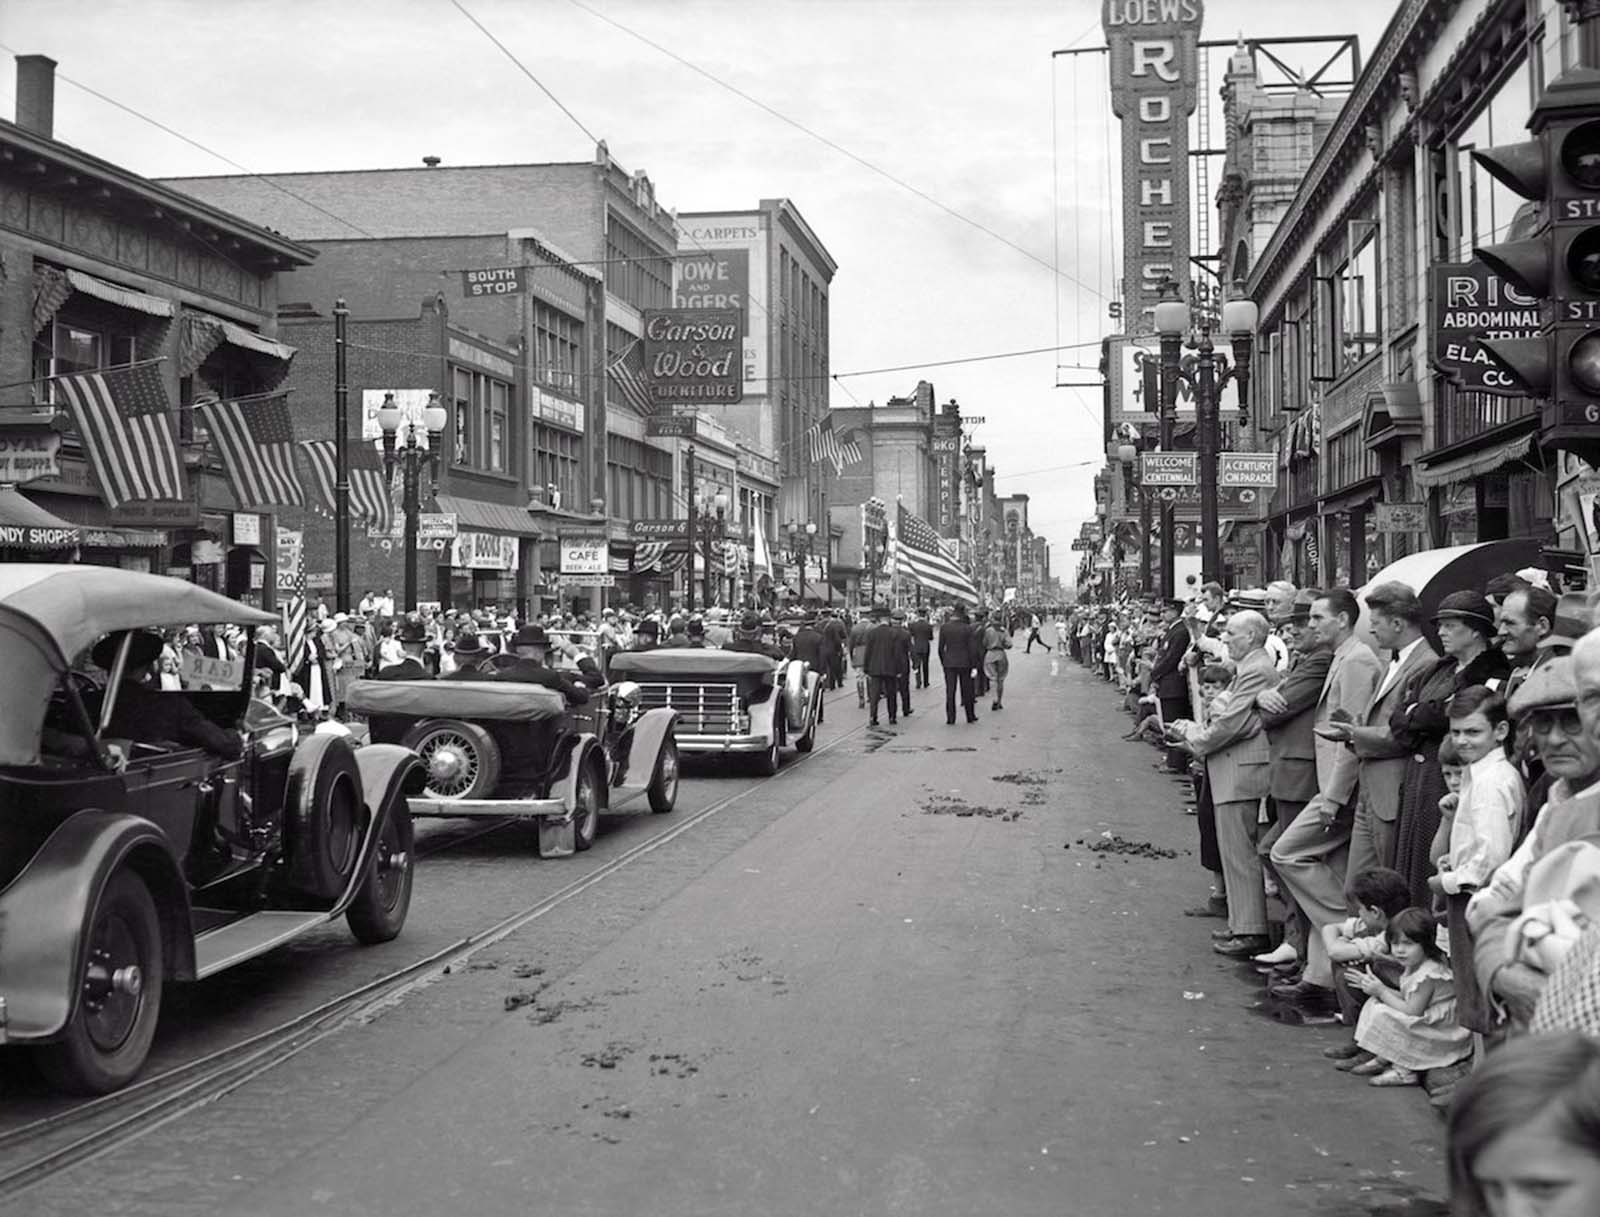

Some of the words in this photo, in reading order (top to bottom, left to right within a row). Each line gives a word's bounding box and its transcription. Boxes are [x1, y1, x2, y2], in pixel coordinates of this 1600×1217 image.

[1567, 200, 1600, 217] ST
[692, 227, 757, 239] CARPETS
[468, 269, 516, 282] SOUTH
[472, 282, 518, 295] STOP
[1443, 311, 1540, 328] ABDOMINAL
[654, 351, 733, 377] Wood
[1146, 458, 1193, 467] WELCOME
[1233, 460, 1273, 471] CENTURY
[1145, 473, 1193, 482] CENTENNIAL
[1240, 473, 1273, 483] PARADE
[941, 455, 949, 526] TEMPLE
[634, 522, 675, 532] Garson
[568, 551, 599, 561] CAFE
